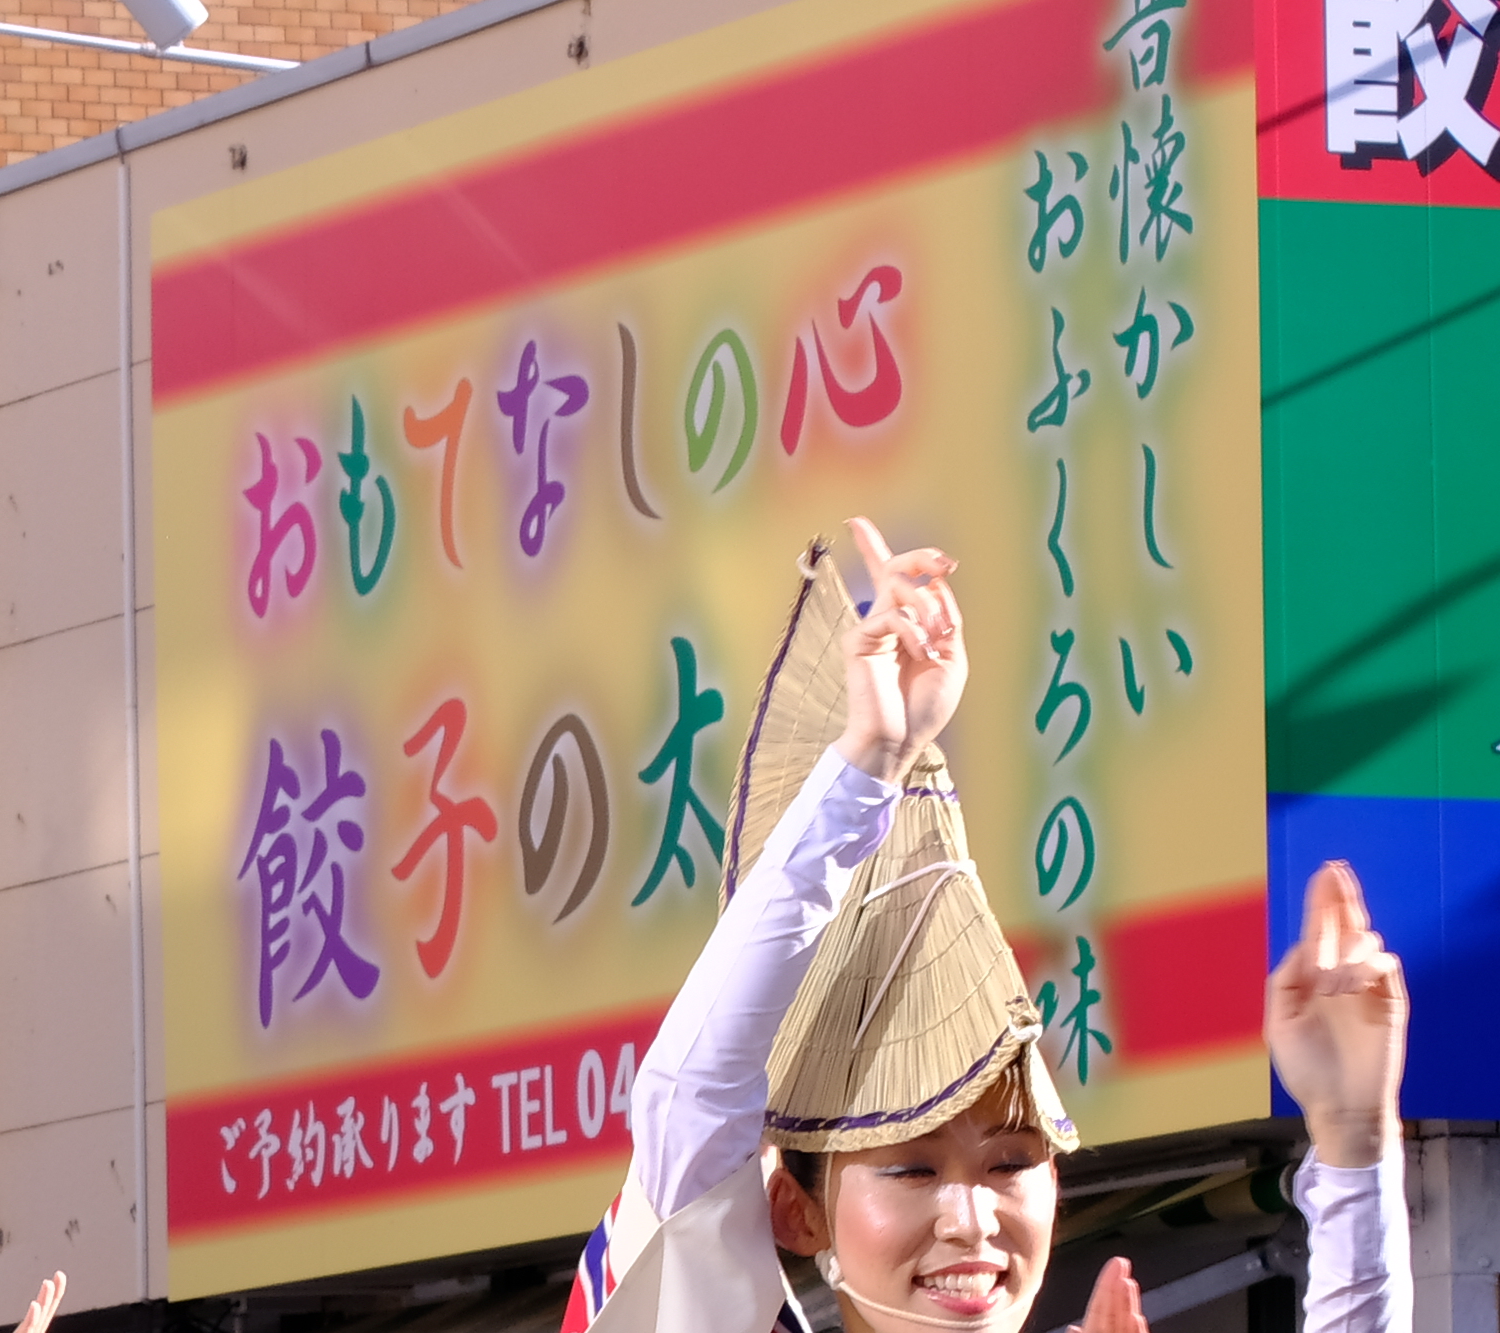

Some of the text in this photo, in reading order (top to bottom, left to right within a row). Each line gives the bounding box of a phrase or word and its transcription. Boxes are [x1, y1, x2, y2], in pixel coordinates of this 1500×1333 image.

[241, 264, 902, 619] おもてなしの心
[218, 1082, 477, 1199] ご予約承ります
[499, 1063, 568, 1153] TEL
